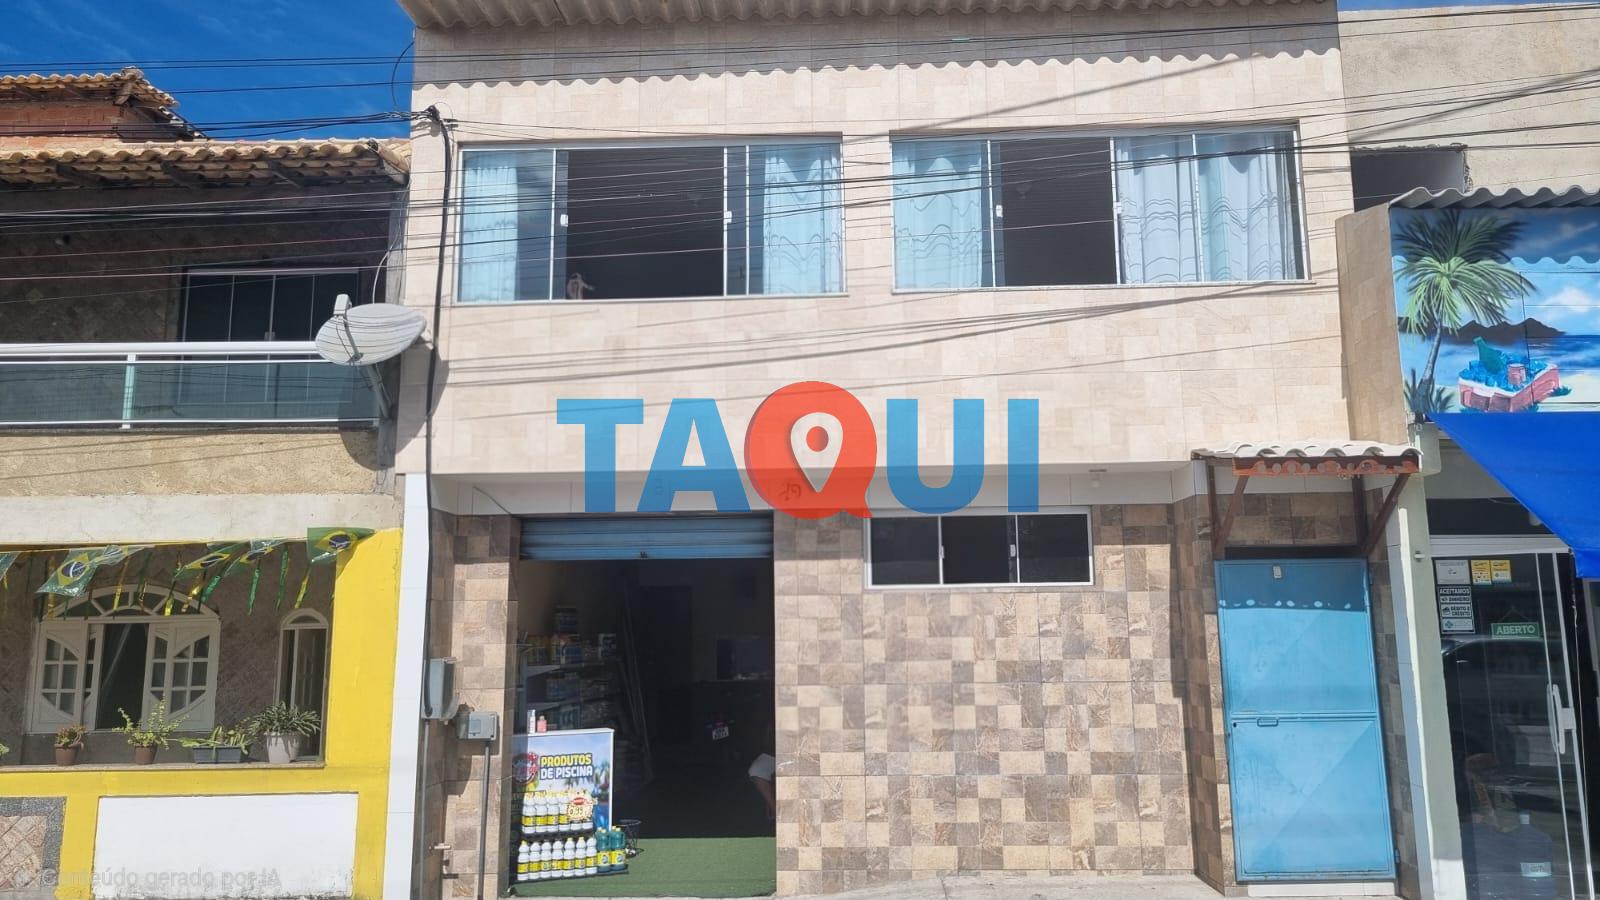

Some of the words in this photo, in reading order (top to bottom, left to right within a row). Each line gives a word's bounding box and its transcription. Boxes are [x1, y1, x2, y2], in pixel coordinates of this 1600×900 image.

[1496, 625, 1536, 635] ABERTO
[540, 753, 592, 767] PRODUTOS
[540, 767, 554, 780] DE
[555, 765, 593, 779] PISCINA
